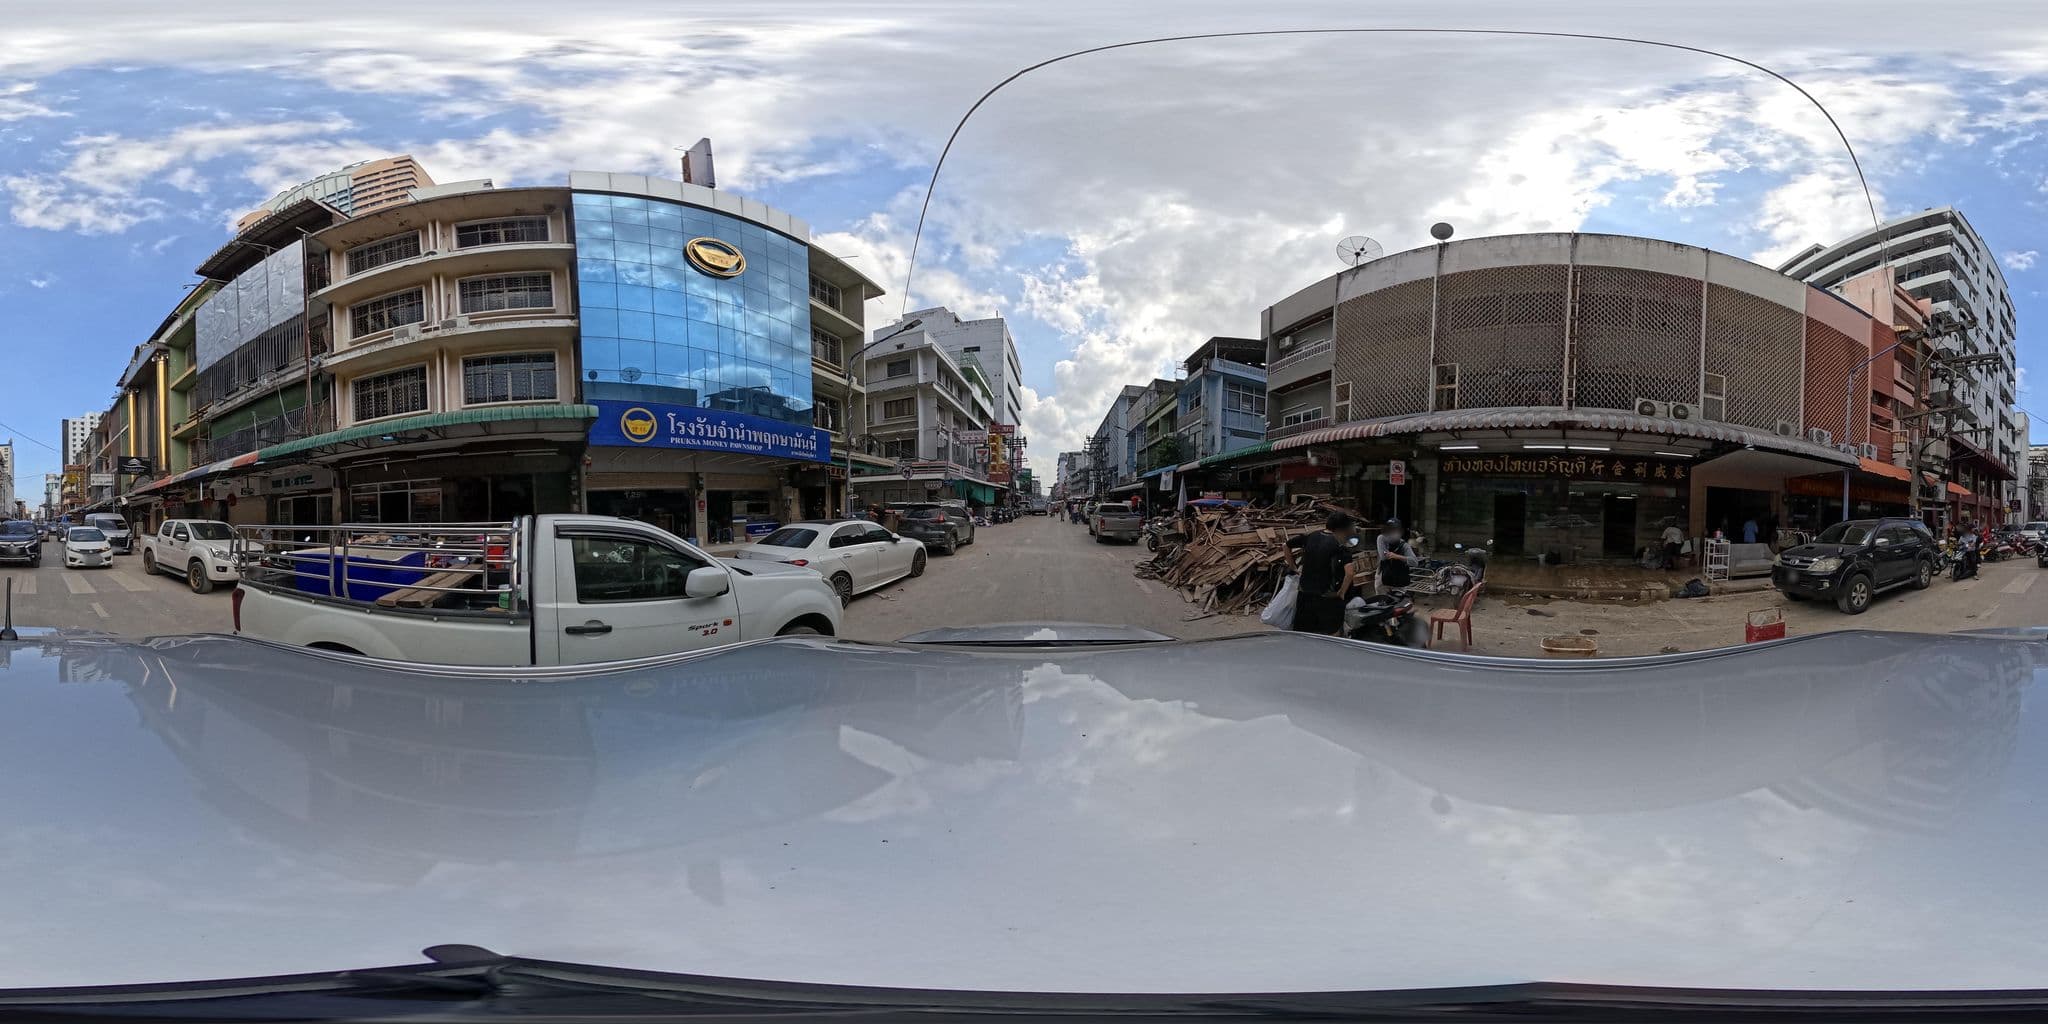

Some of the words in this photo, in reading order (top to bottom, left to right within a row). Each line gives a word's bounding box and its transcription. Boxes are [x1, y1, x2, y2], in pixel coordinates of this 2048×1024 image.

[667, 412, 816, 451] โรงรับจำนำพฤกษามันนี่
[670, 437, 702, 446] PRUKSA
[702, 439, 730, 448] MONEY
[730, 442, 763, 452] PAWNSHOP
[688, 622, 718, 631] Spark
